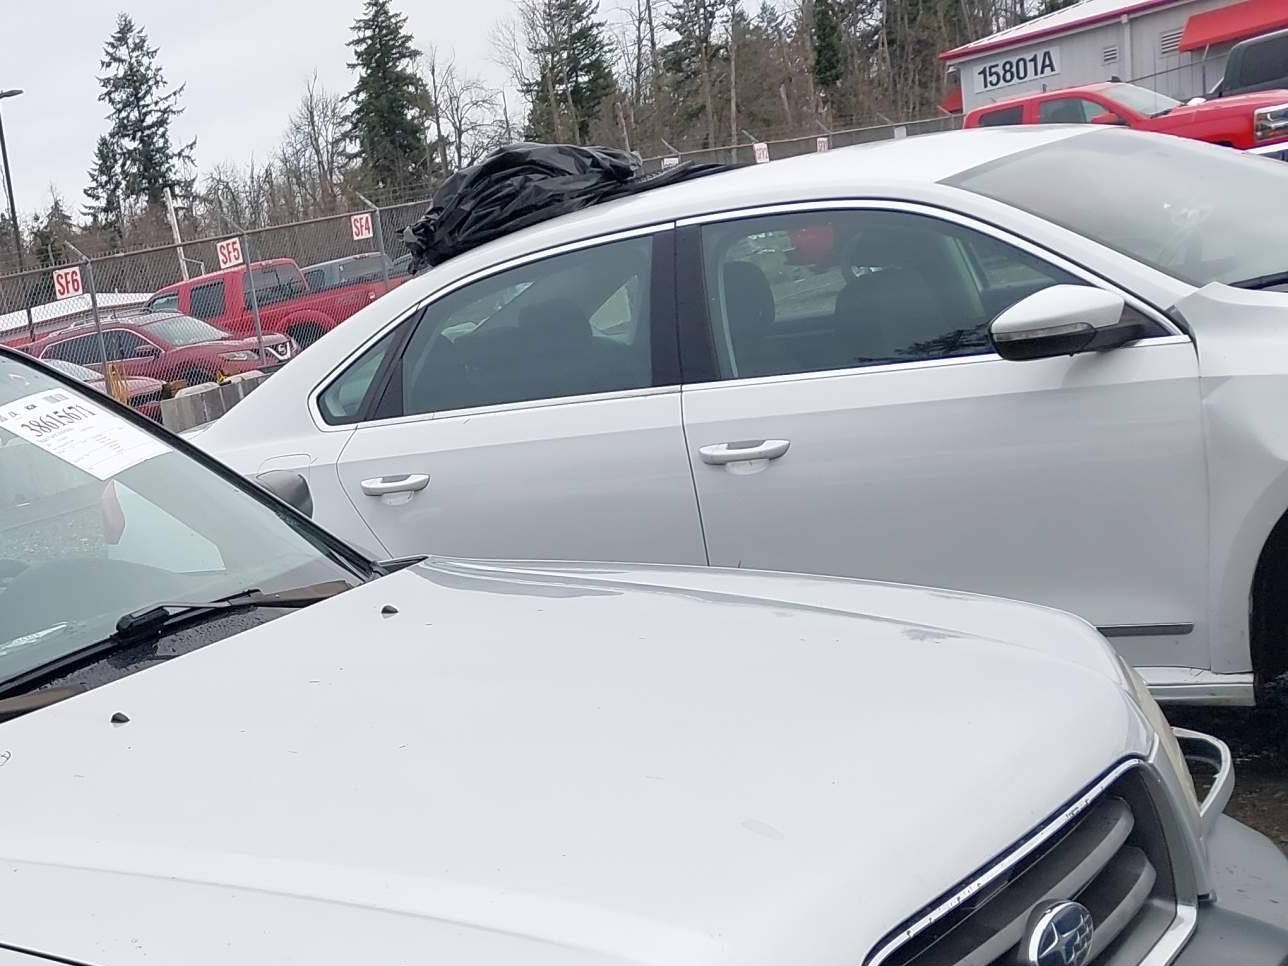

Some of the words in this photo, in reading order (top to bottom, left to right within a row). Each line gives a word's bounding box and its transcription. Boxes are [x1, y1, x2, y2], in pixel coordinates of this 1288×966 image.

[978, 50, 1056, 89] 15801A
[353, 216, 371, 237] SF4
[220, 241, 240, 264] SF5
[56, 270, 80, 295] SF6
[20, 404, 96, 437] 38615671
